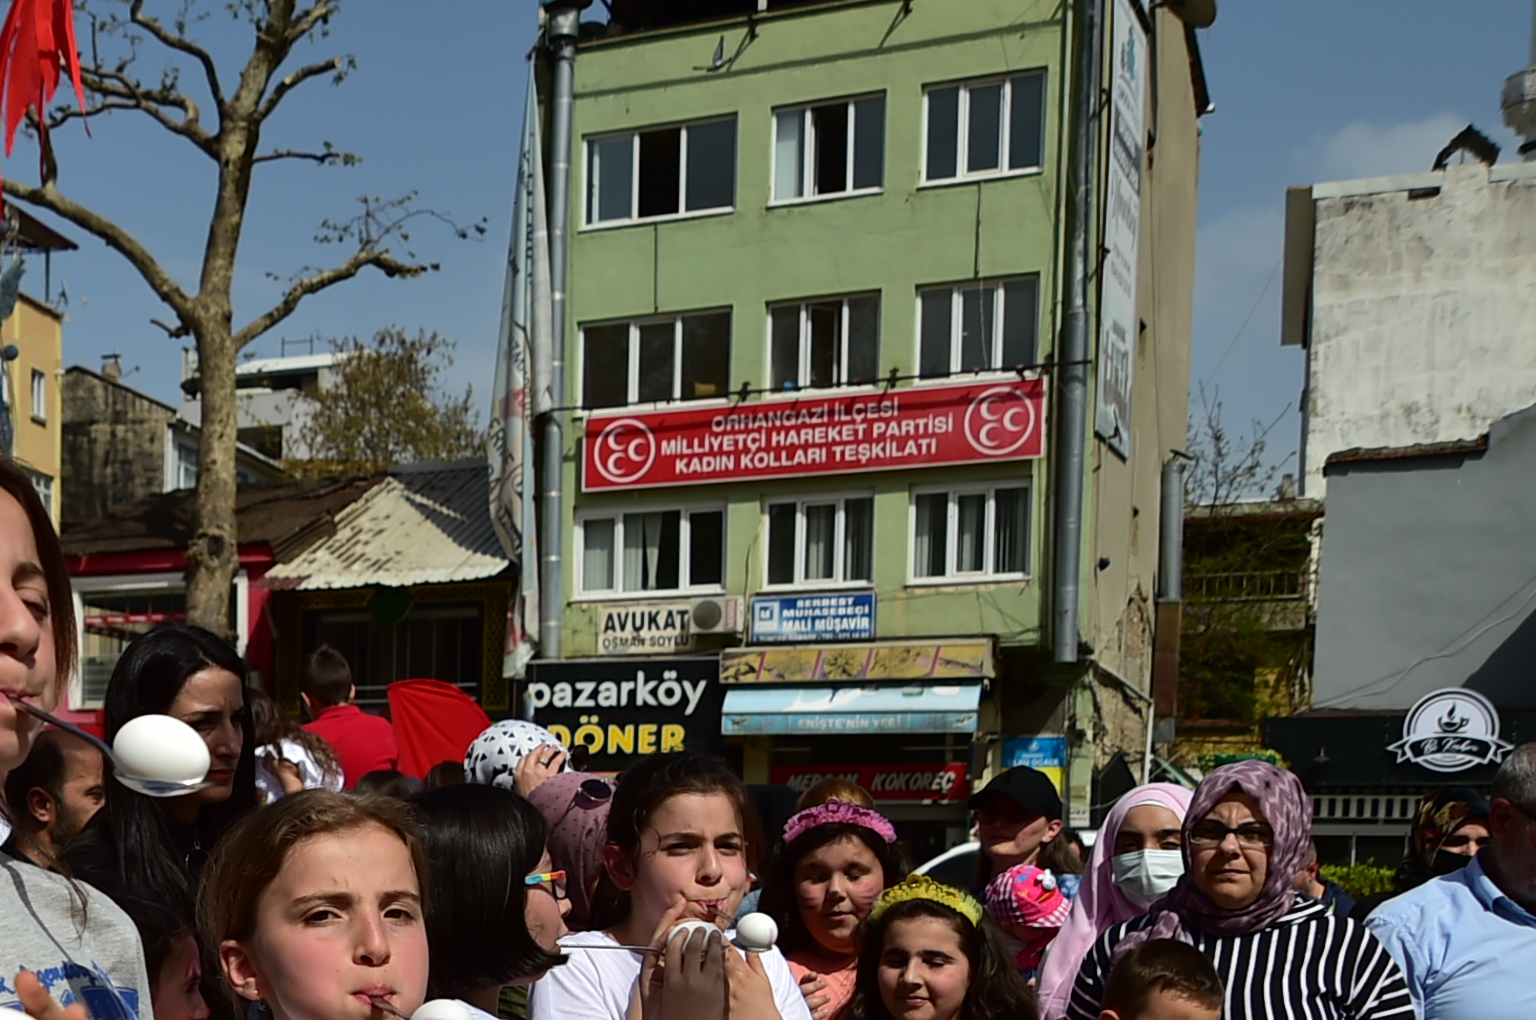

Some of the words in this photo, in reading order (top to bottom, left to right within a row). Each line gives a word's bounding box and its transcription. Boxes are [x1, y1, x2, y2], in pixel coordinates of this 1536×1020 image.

[711, 403, 829, 433] ORHANGAZİ
[834, 397, 899, 422] İLÇESİ
[661, 429, 765, 457] MİLLİYETÇİ
[771, 423, 867, 448] HAREKET
[872, 413, 954, 437] PARTİSİ
[675, 455, 734, 475] KADIN
[740, 447, 826, 470] KOLLARI
[832, 438, 937, 463] TEŞKİLATI
[782, 605, 870, 618] MUHASEBECİ
[796, 597, 855, 608] SERBEST
[603, 610, 689, 634] AVUKAT
[782, 617, 812, 632] MALİ
[815, 615, 870, 633] MÜŞAVİR
[602, 636, 645, 650] OSMAN
[649, 634, 690, 647] SOYLU
[528, 670, 707, 716] pazarköy
[547, 715, 685, 755] DÖNER
[871, 771, 958, 794] KOKOREÇ
